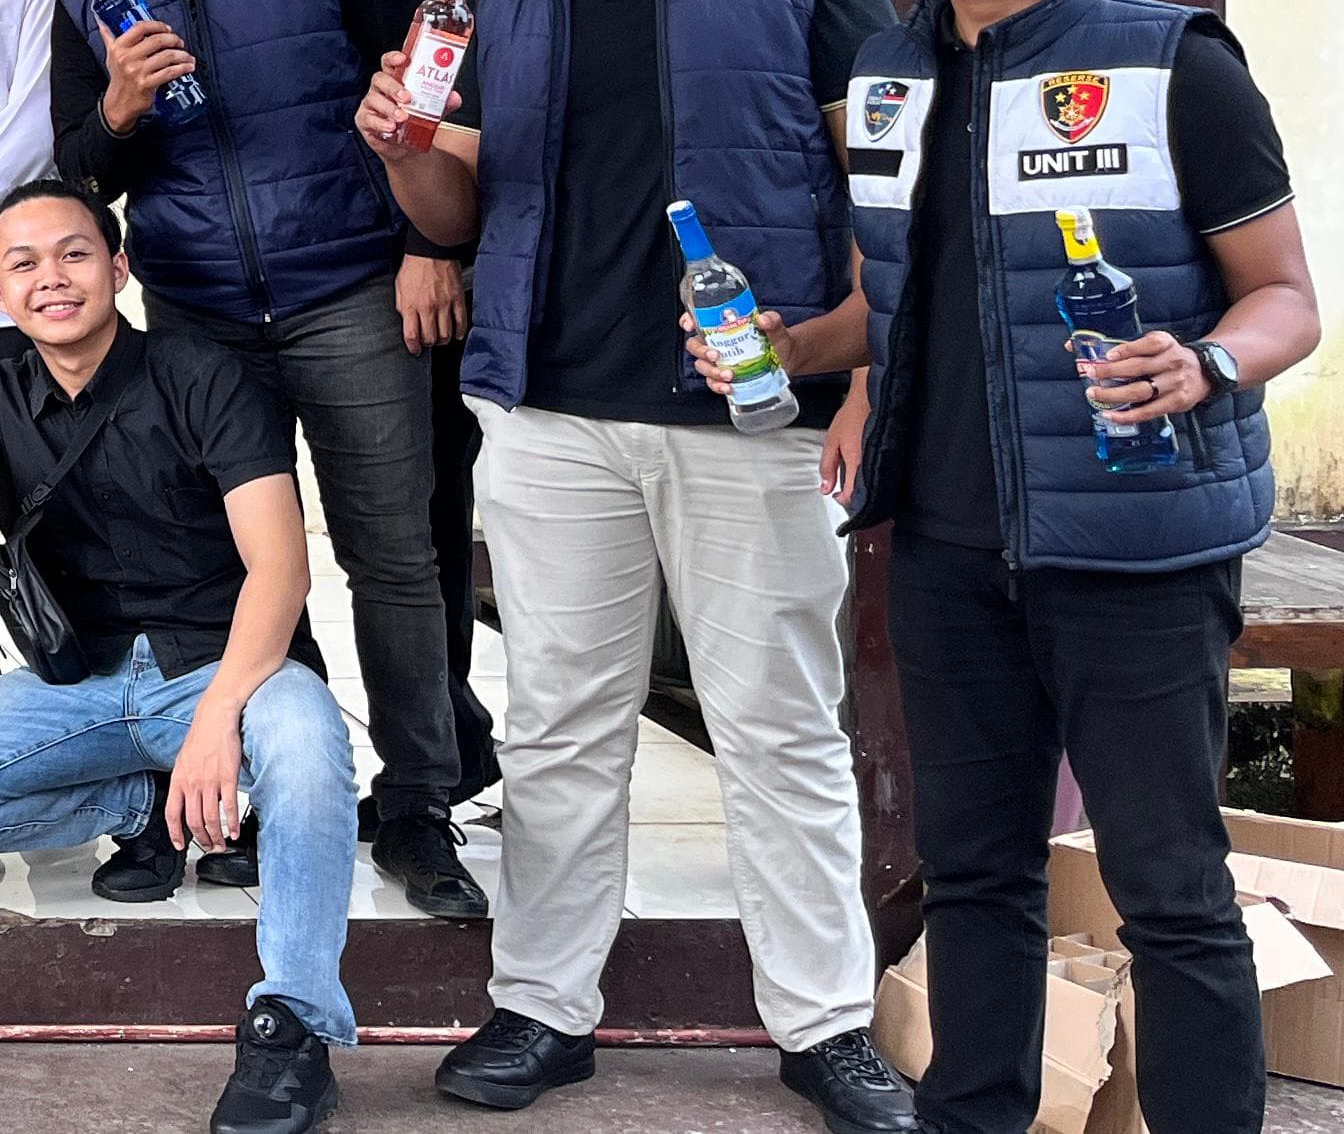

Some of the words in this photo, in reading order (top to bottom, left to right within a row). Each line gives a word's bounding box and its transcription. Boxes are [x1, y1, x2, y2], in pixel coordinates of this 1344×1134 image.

[416, 64, 453, 84] ATLAS
[1022, 150, 1089, 175] UNIT
[1096, 148, 1121, 172] III
